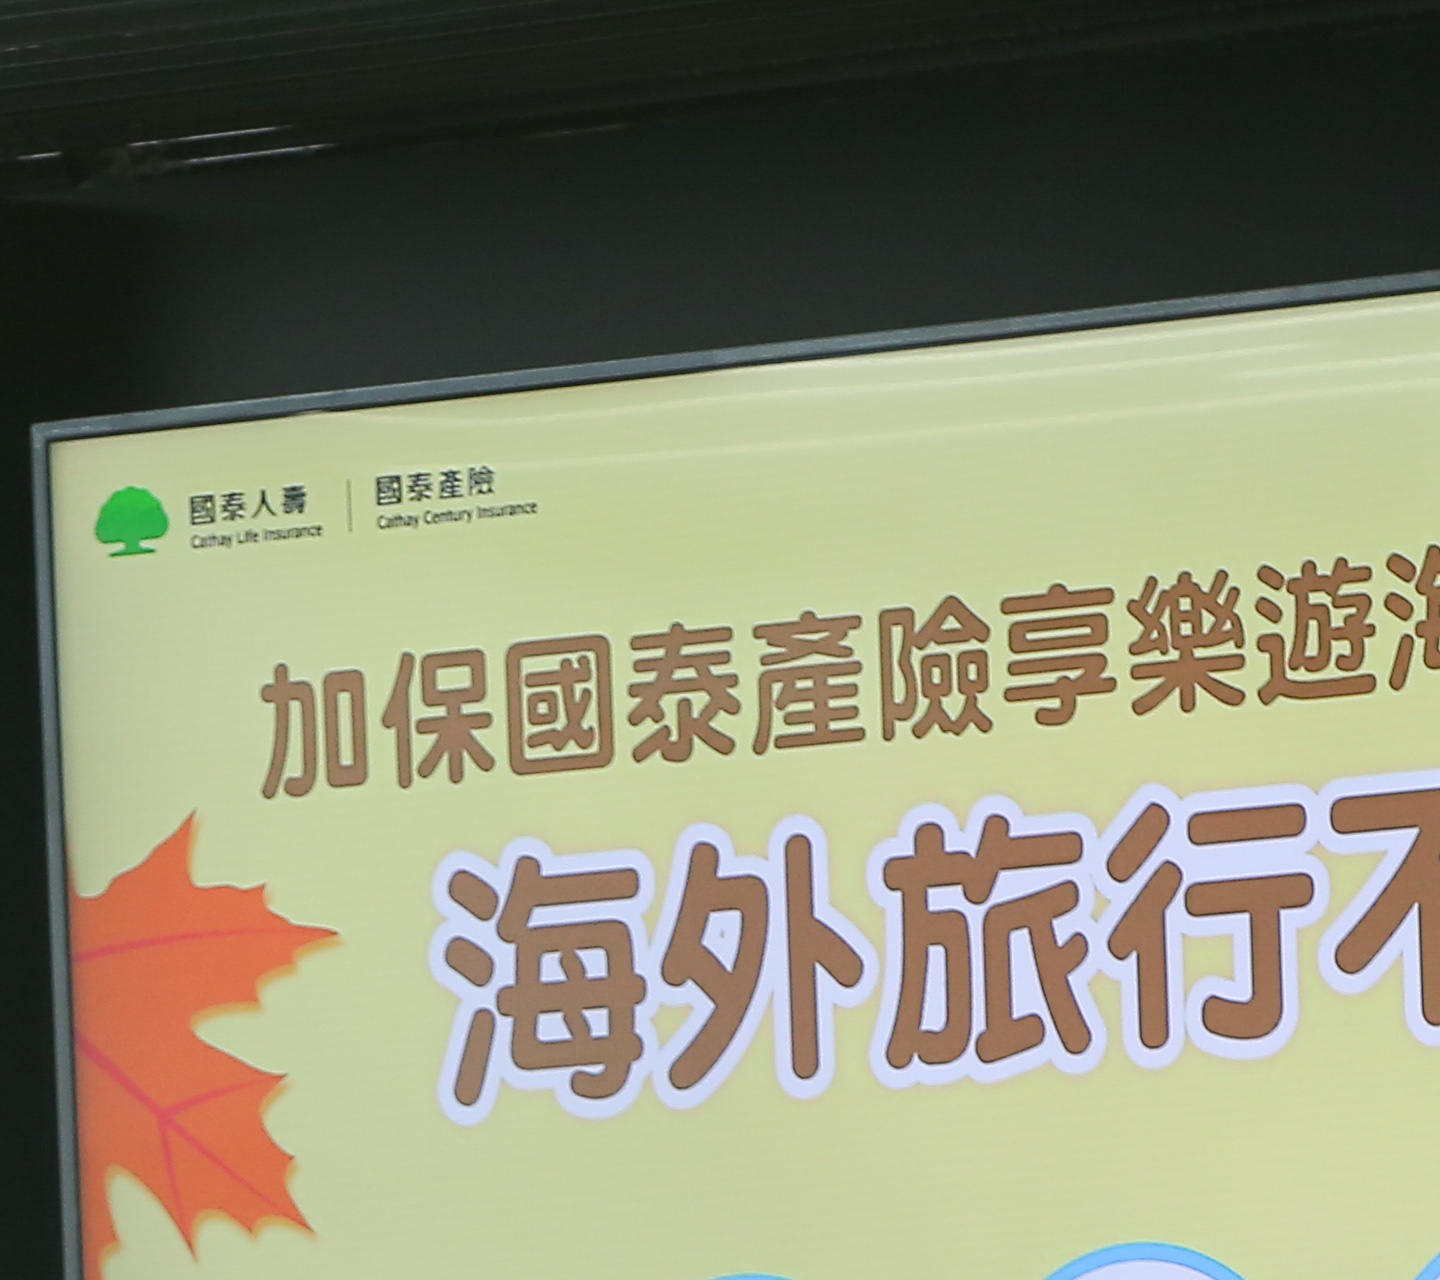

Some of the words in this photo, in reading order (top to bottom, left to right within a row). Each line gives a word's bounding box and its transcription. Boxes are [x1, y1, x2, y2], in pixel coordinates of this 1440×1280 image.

[376, 465, 495, 506] 國泰產險
[189, 484, 308, 526] 國泰人壽
[377, 514, 419, 530] Cathay
[423, 509, 472, 525] Century
[476, 502, 538, 519] Insurance
[190, 533, 233, 549] Cathay
[236, 529, 260, 544] Life
[263, 524, 324, 541] Insurance
